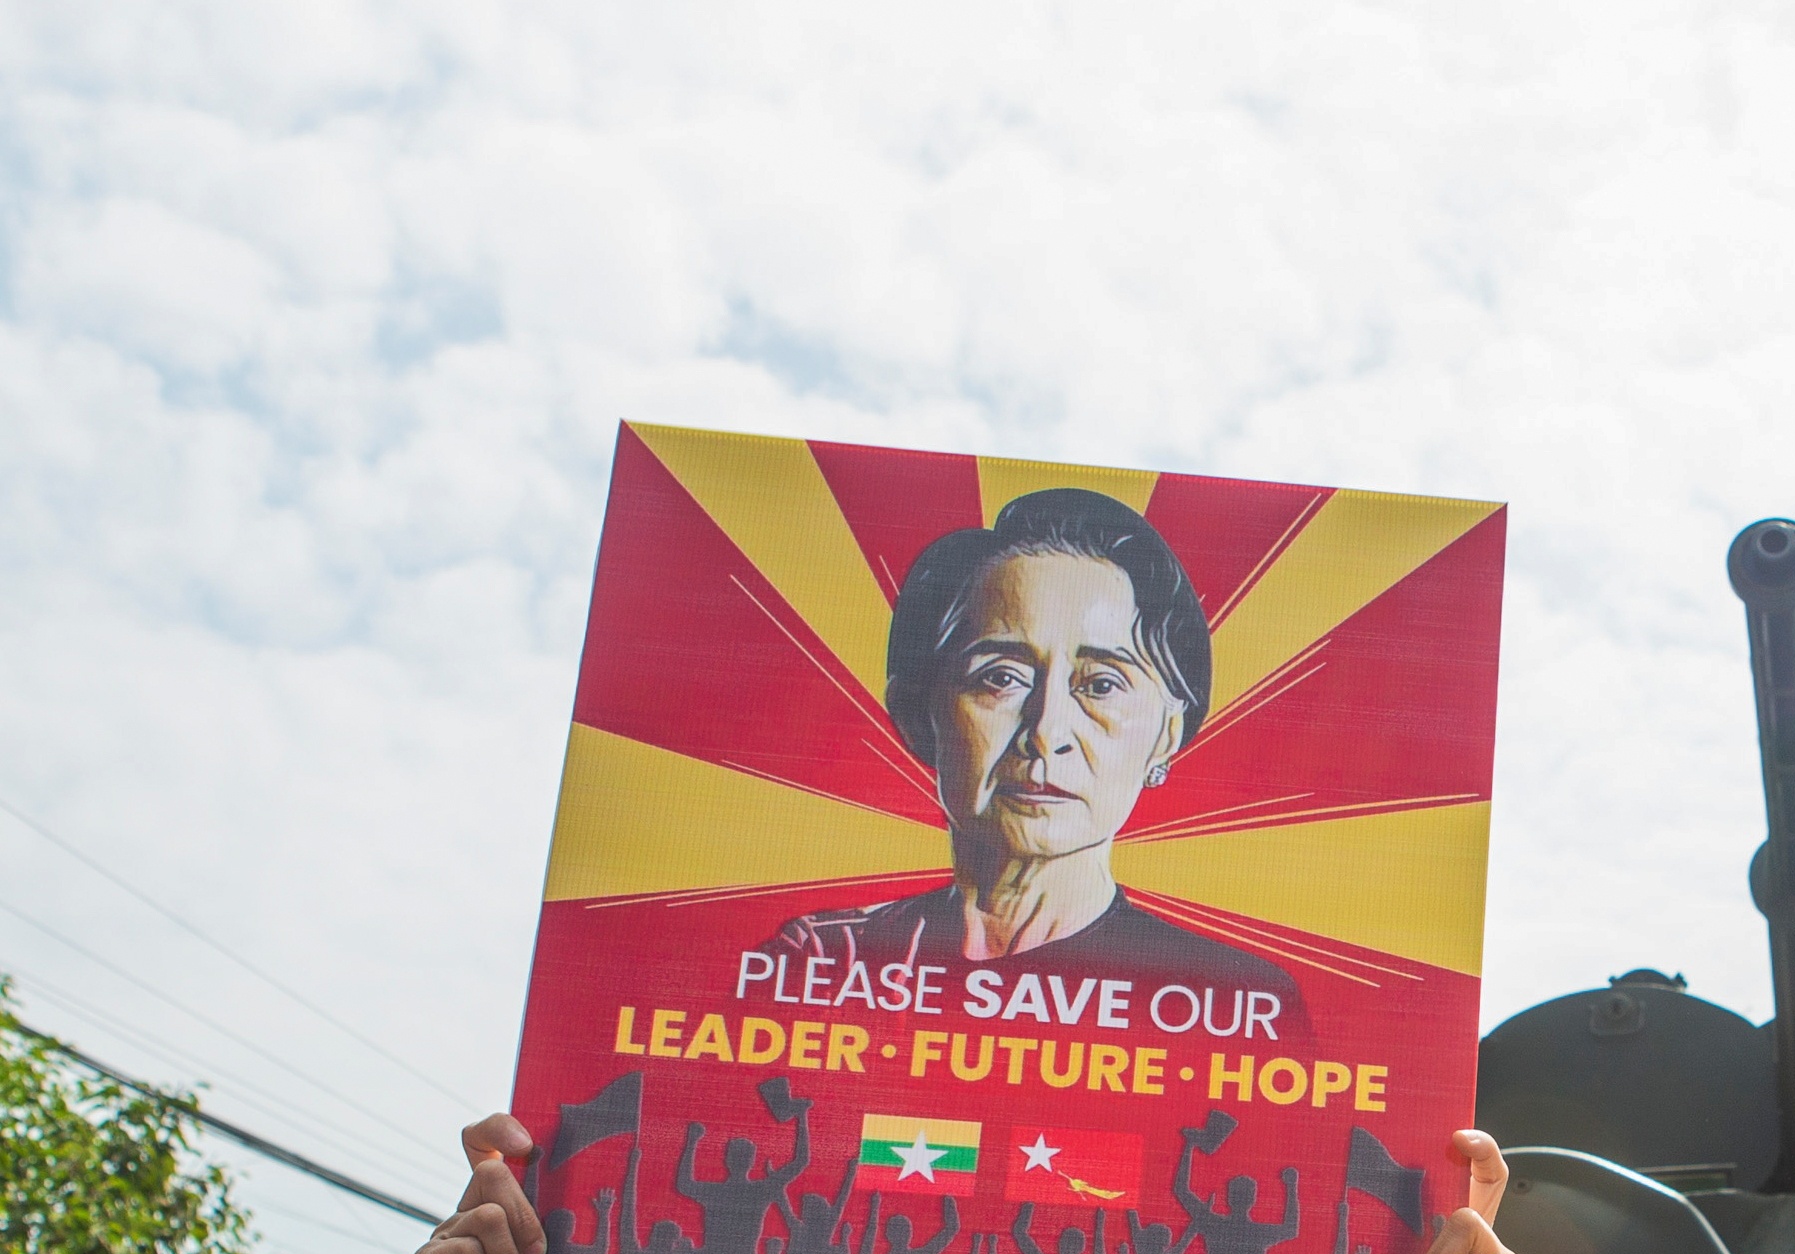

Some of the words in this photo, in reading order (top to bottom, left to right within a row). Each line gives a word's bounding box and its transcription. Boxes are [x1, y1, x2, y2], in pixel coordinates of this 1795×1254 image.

[735, 951, 946, 1015] PLEASE
[963, 969, 1133, 1029] SAVE
[1150, 984, 1282, 1041] OUR
[615, 1006, 870, 1073] LEADER
[910, 1030, 1168, 1096] FUTURE
[1208, 1052, 1387, 1112] HOPE
